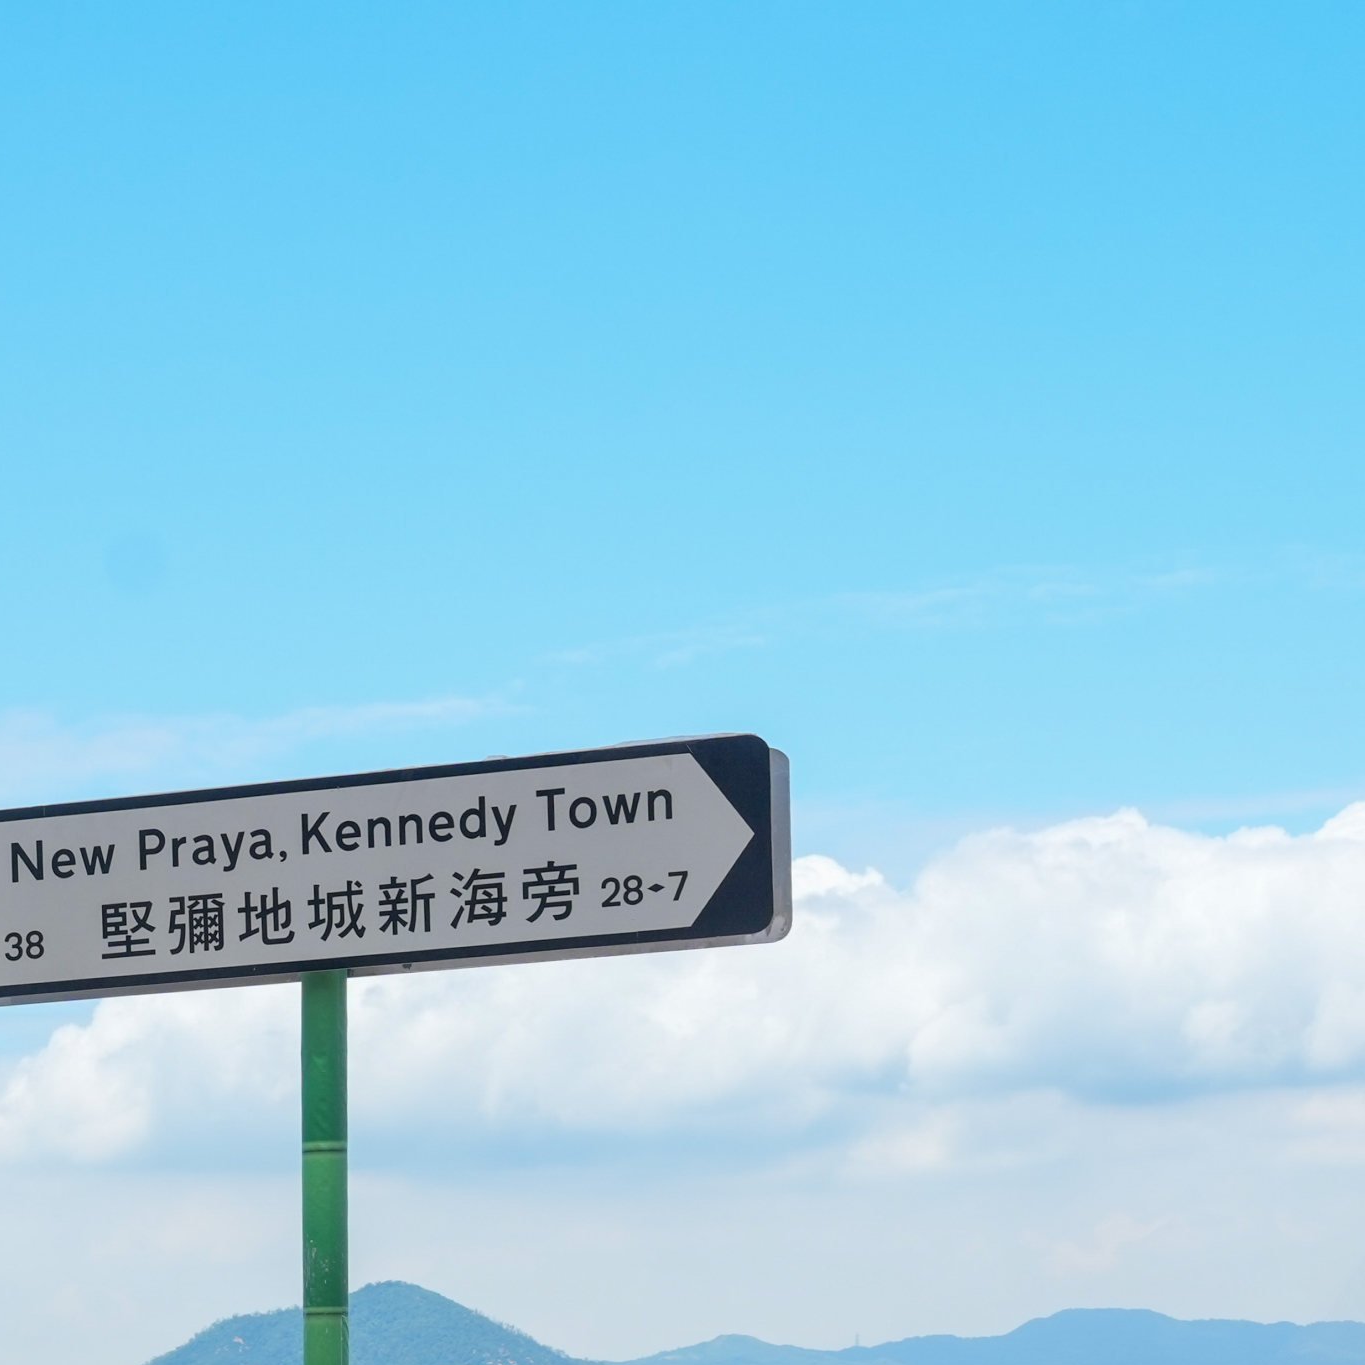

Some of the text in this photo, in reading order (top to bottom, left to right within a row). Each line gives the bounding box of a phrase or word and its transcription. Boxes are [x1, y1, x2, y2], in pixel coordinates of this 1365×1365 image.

[10, 787, 673, 884] New Praya, Kennedy Town
[4, 930, 45, 962] 38
[100, 860, 581, 961] 堅彌地城新海旁
